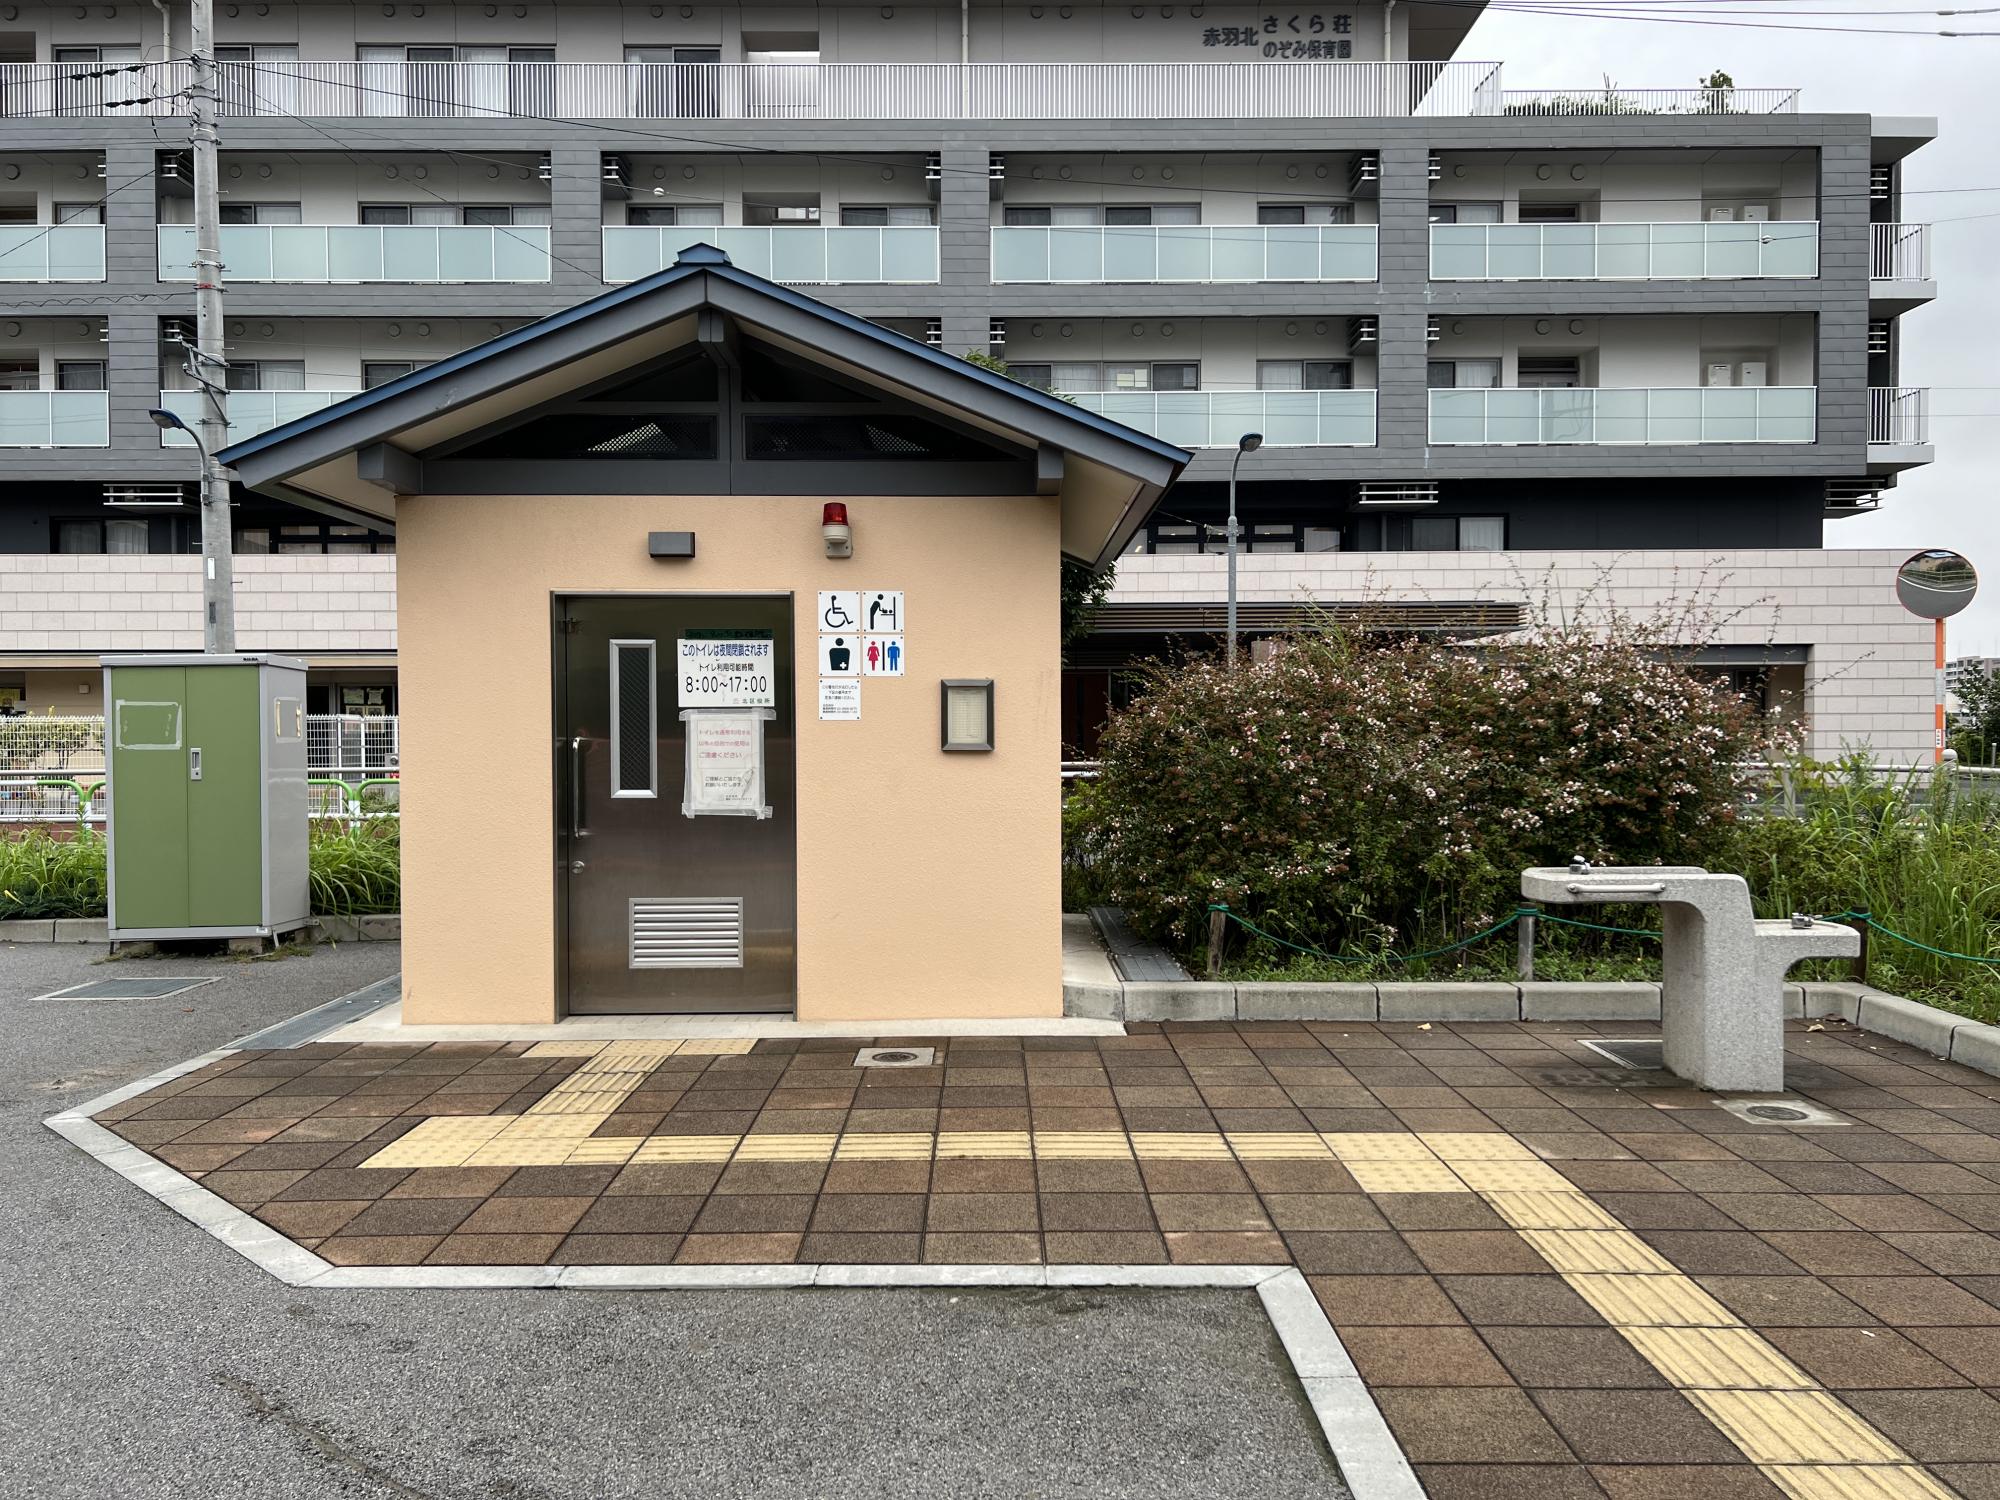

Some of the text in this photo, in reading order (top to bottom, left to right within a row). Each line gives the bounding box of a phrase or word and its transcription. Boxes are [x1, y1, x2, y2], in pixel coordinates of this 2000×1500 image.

[1263, 14, 1352, 34] さくら荘
[1202, 27, 1259, 47] 赤羽北
[1262, 40, 1352, 59] のぞみ保育園
[682, 643, 769, 657] このトイレは夜間閉鎖されます
[699, 663, 755, 672] トイレ利用可能時間
